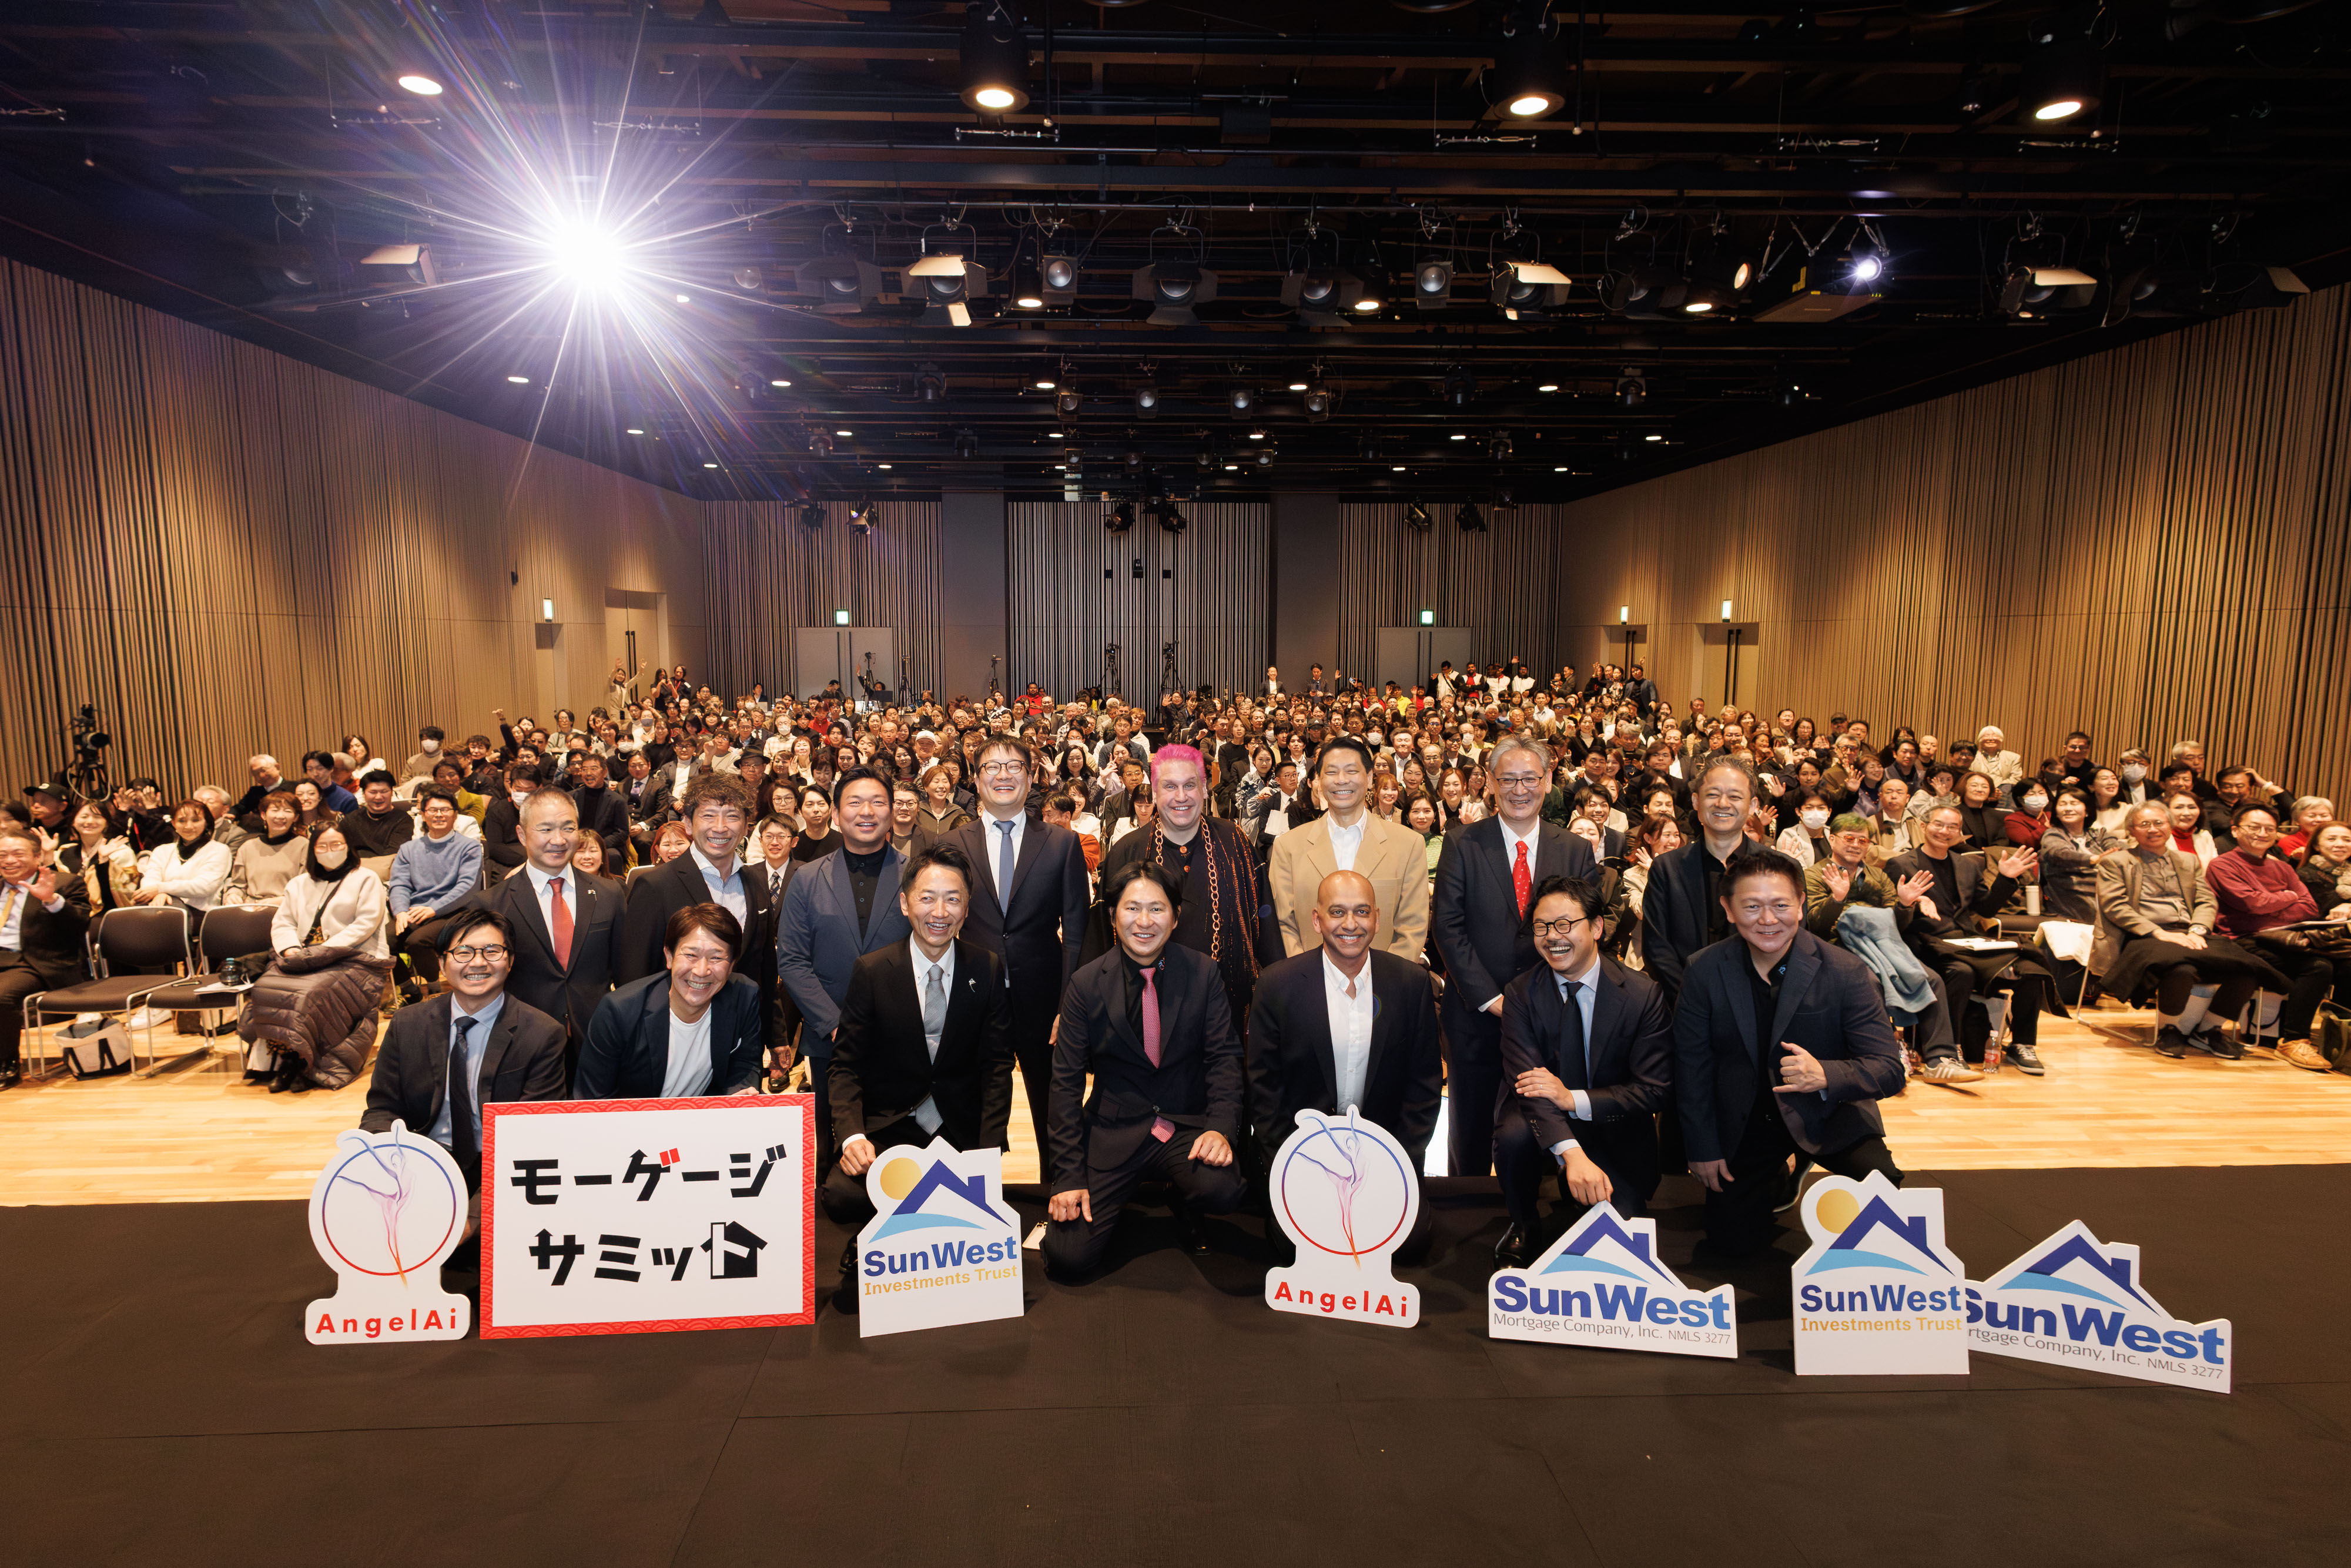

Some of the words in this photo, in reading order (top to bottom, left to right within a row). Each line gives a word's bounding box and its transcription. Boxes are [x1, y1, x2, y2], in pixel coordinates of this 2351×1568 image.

[511, 1144, 786, 1205] モーゲージ
[528, 1221, 768, 1286] サミット
[865, 1236, 1017, 1276] SunWest
[865, 1272, 970, 1295] Investments
[974, 1265, 1017, 1281] Trust
[1274, 1282, 1407, 1317] AngelAi
[1494, 1276, 1731, 1330] SunWest
[1800, 1284, 1961, 1312] SunWest
[316, 1308, 457, 1338] AngelAi
[1494, 1313, 1559, 1332] Mortgage
[1564, 1319, 1634, 1338] Company,
[1639, 1325, 1663, 1339] Inc.
[1669, 1330, 1700, 1342] NMLS
[1705, 1333, 1730, 1344] 3277
[1801, 1318, 1911, 1331] Investments
[1915, 1318, 1962, 1331] Trust
[1969, 1328, 2019, 1346] rtgage
[2025, 1335, 2105, 1362] Company,
[2111, 1350, 2140, 1366] Inc.
[2147, 1357, 2186, 1373] NMLS
[2191, 1365, 2223, 1379] 3277
